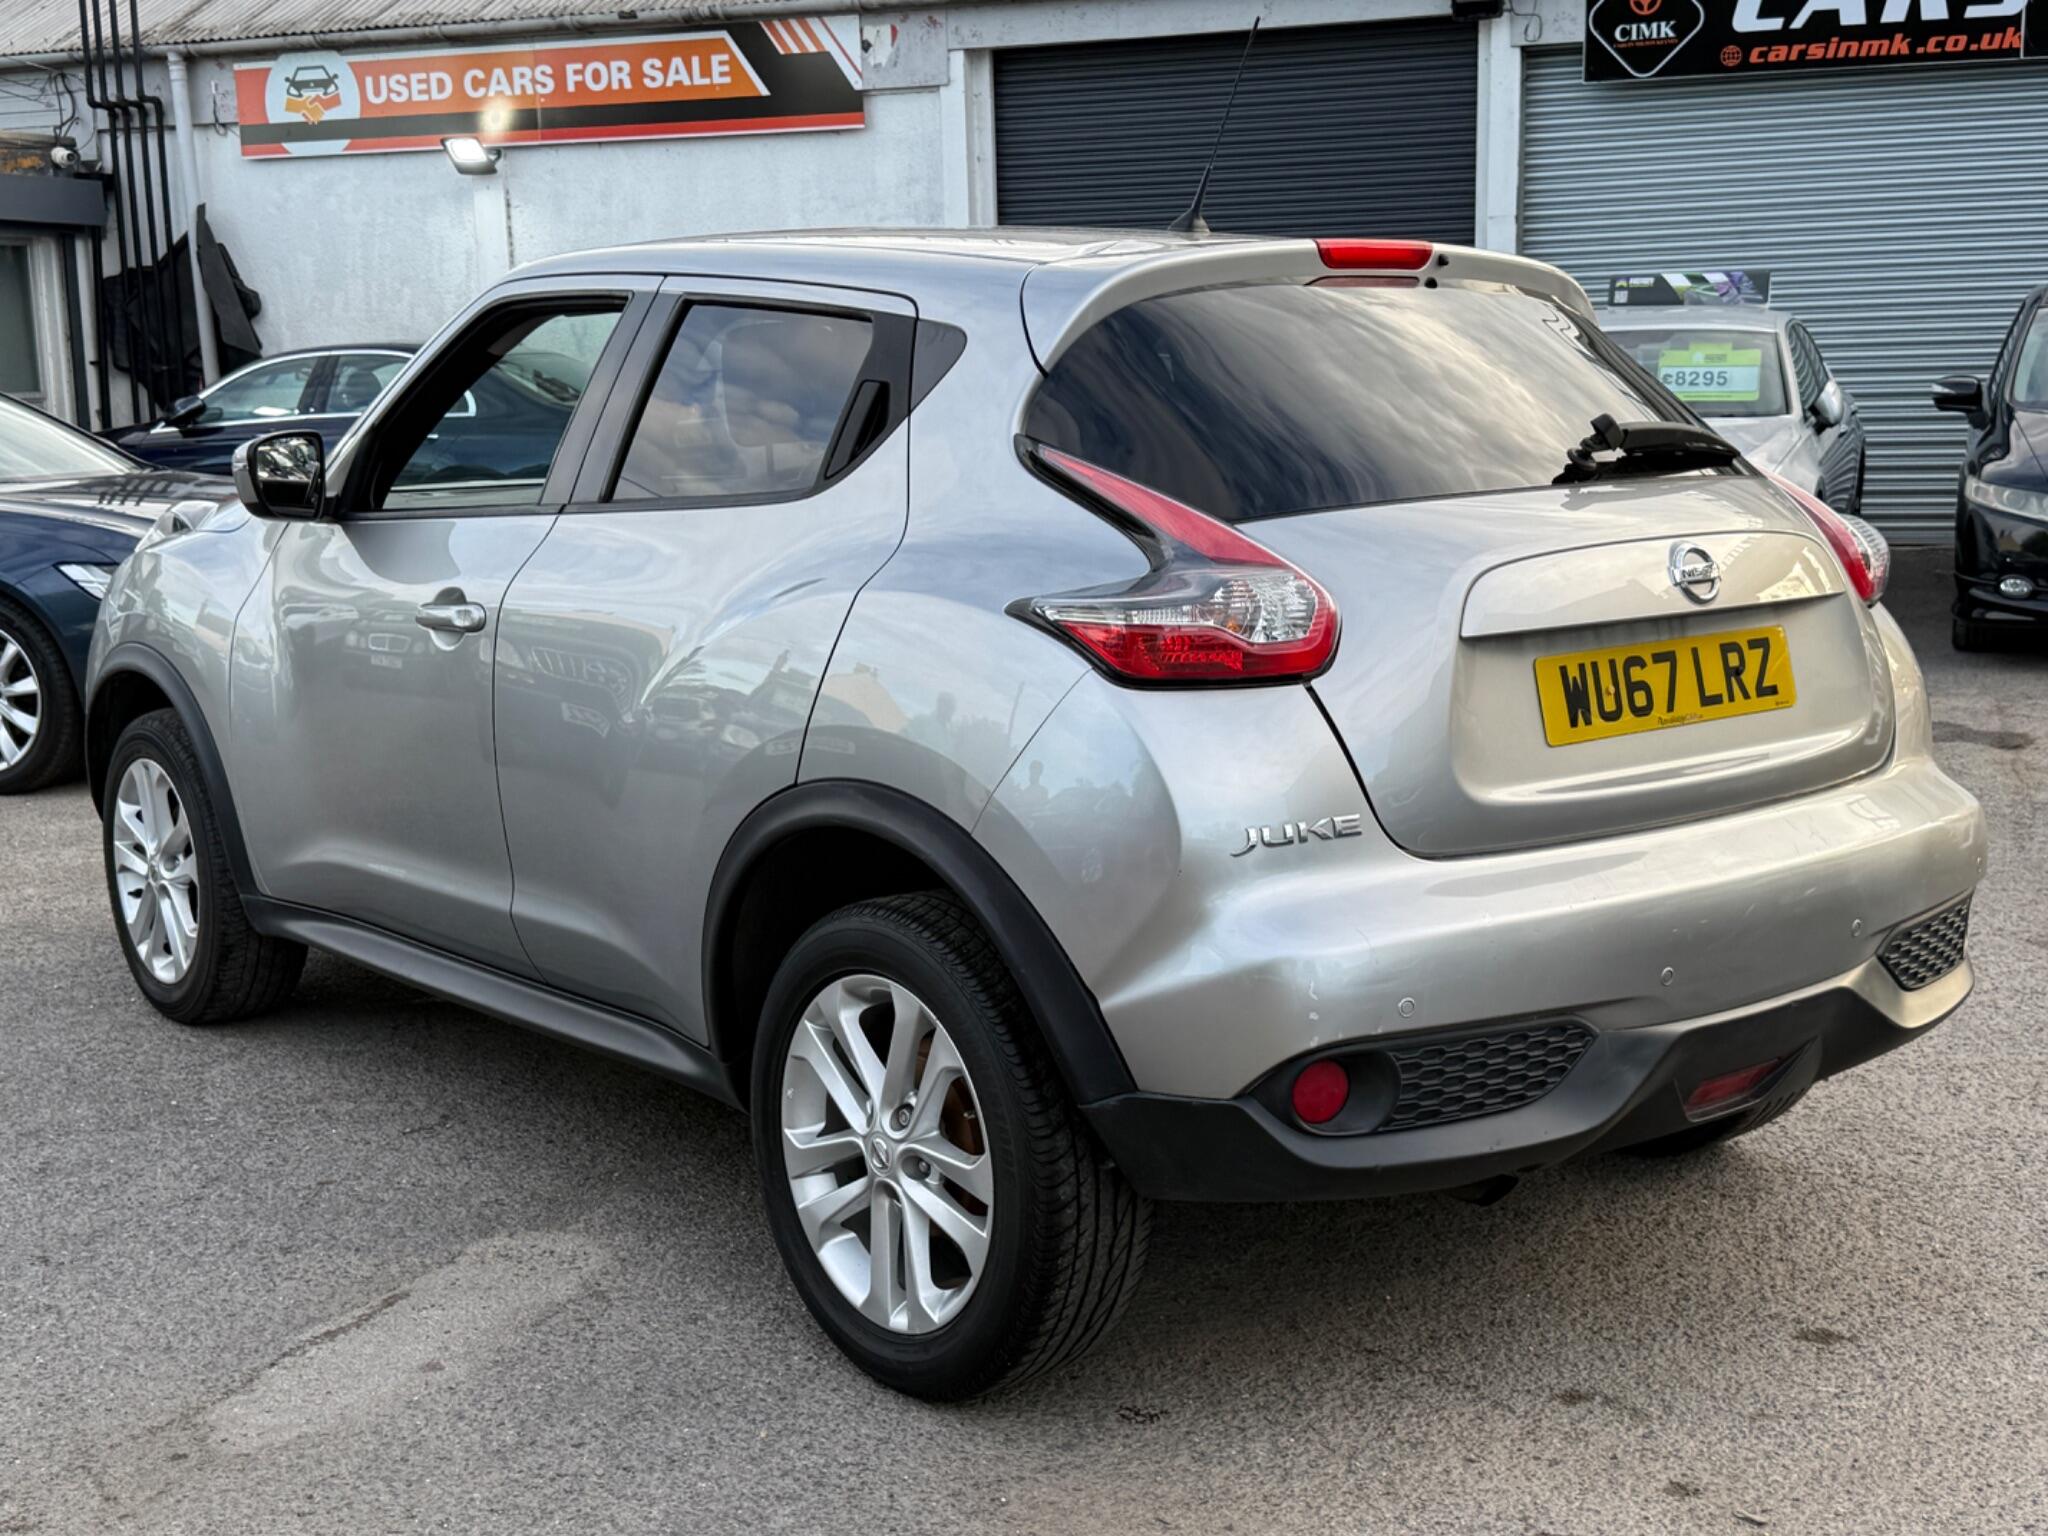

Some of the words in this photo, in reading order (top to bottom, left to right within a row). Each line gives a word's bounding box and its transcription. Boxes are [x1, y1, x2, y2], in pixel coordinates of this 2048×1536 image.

[1614, 20, 1678, 42] CIMK
[365, 72, 453, 105] USED
[464, 65, 555, 98] CARS
[566, 60, 632, 93] FOR
[643, 54, 732, 89] SALE
[1559, 650, 1678, 729] WU67
[1691, 637, 1779, 707] LRZ
[1230, 813, 1362, 857] JUKE
